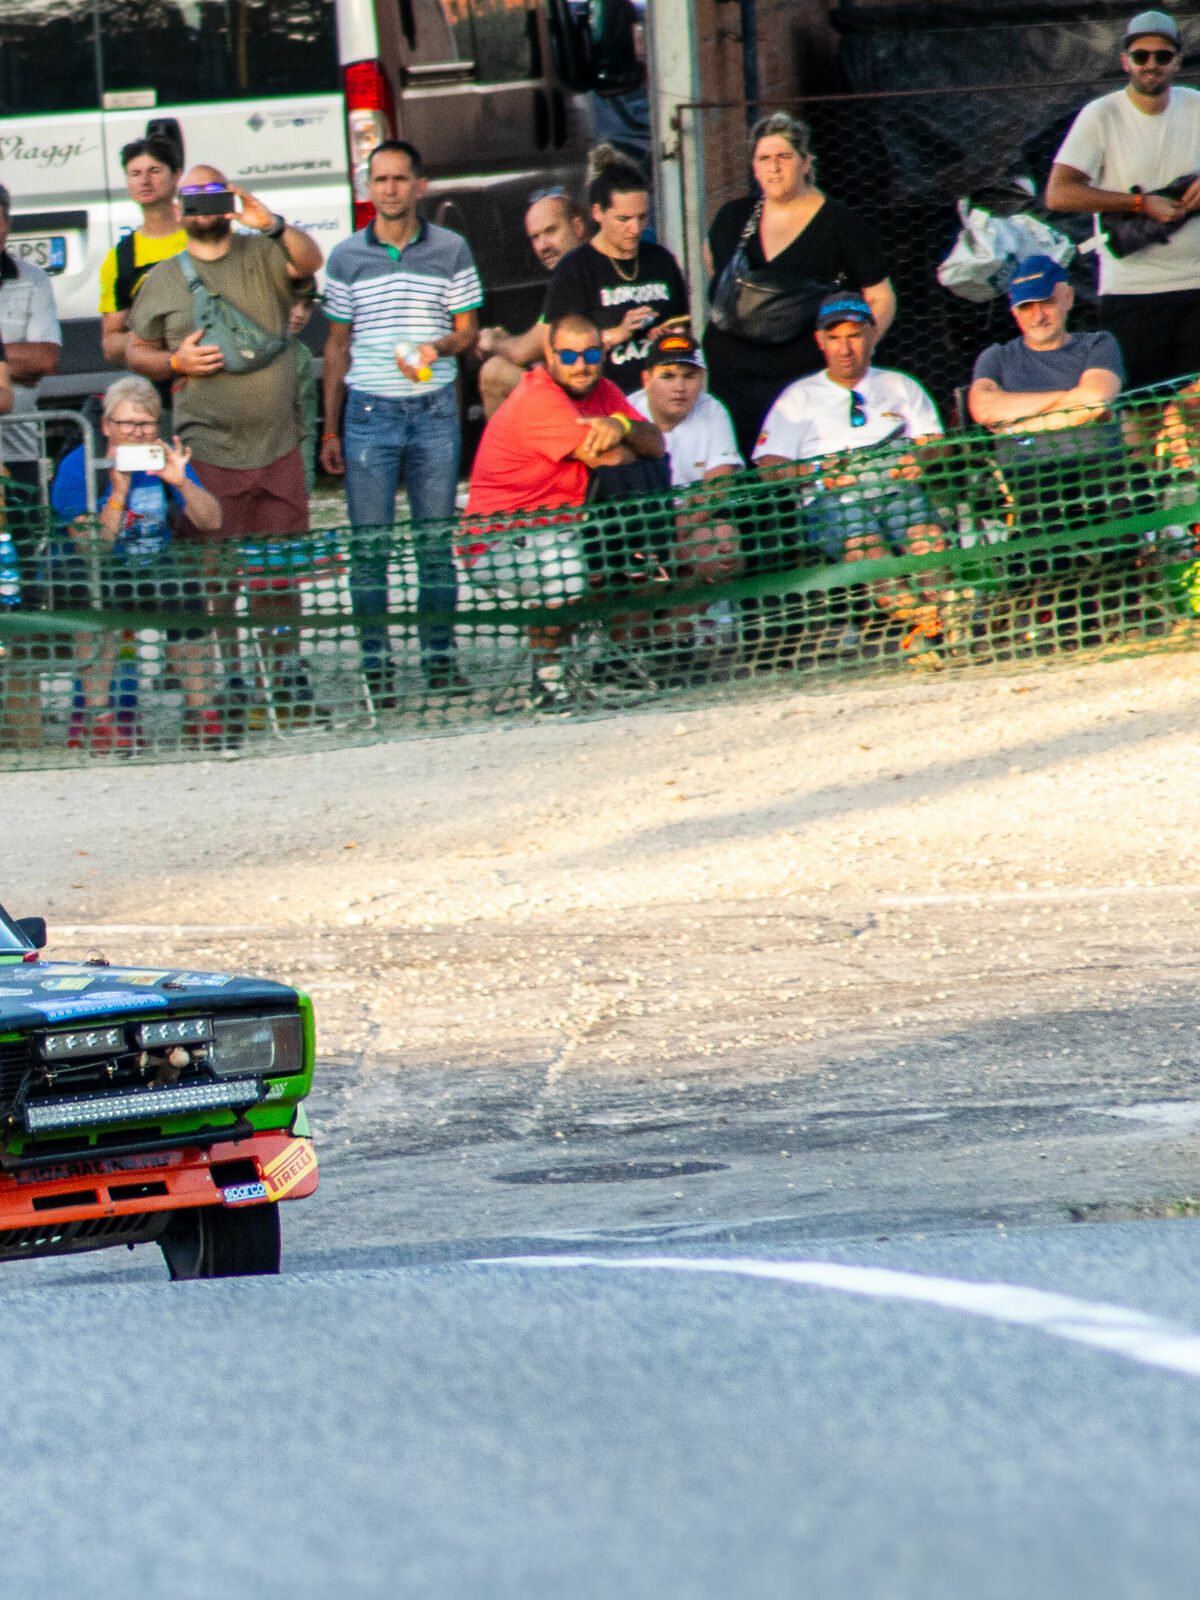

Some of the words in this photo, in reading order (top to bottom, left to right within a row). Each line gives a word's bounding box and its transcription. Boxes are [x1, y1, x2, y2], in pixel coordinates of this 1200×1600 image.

[238, 160, 332, 175] JUMPER
[268, 1145, 312, 1193] PIRELLI
[224, 1184, 267, 1203] sparco
